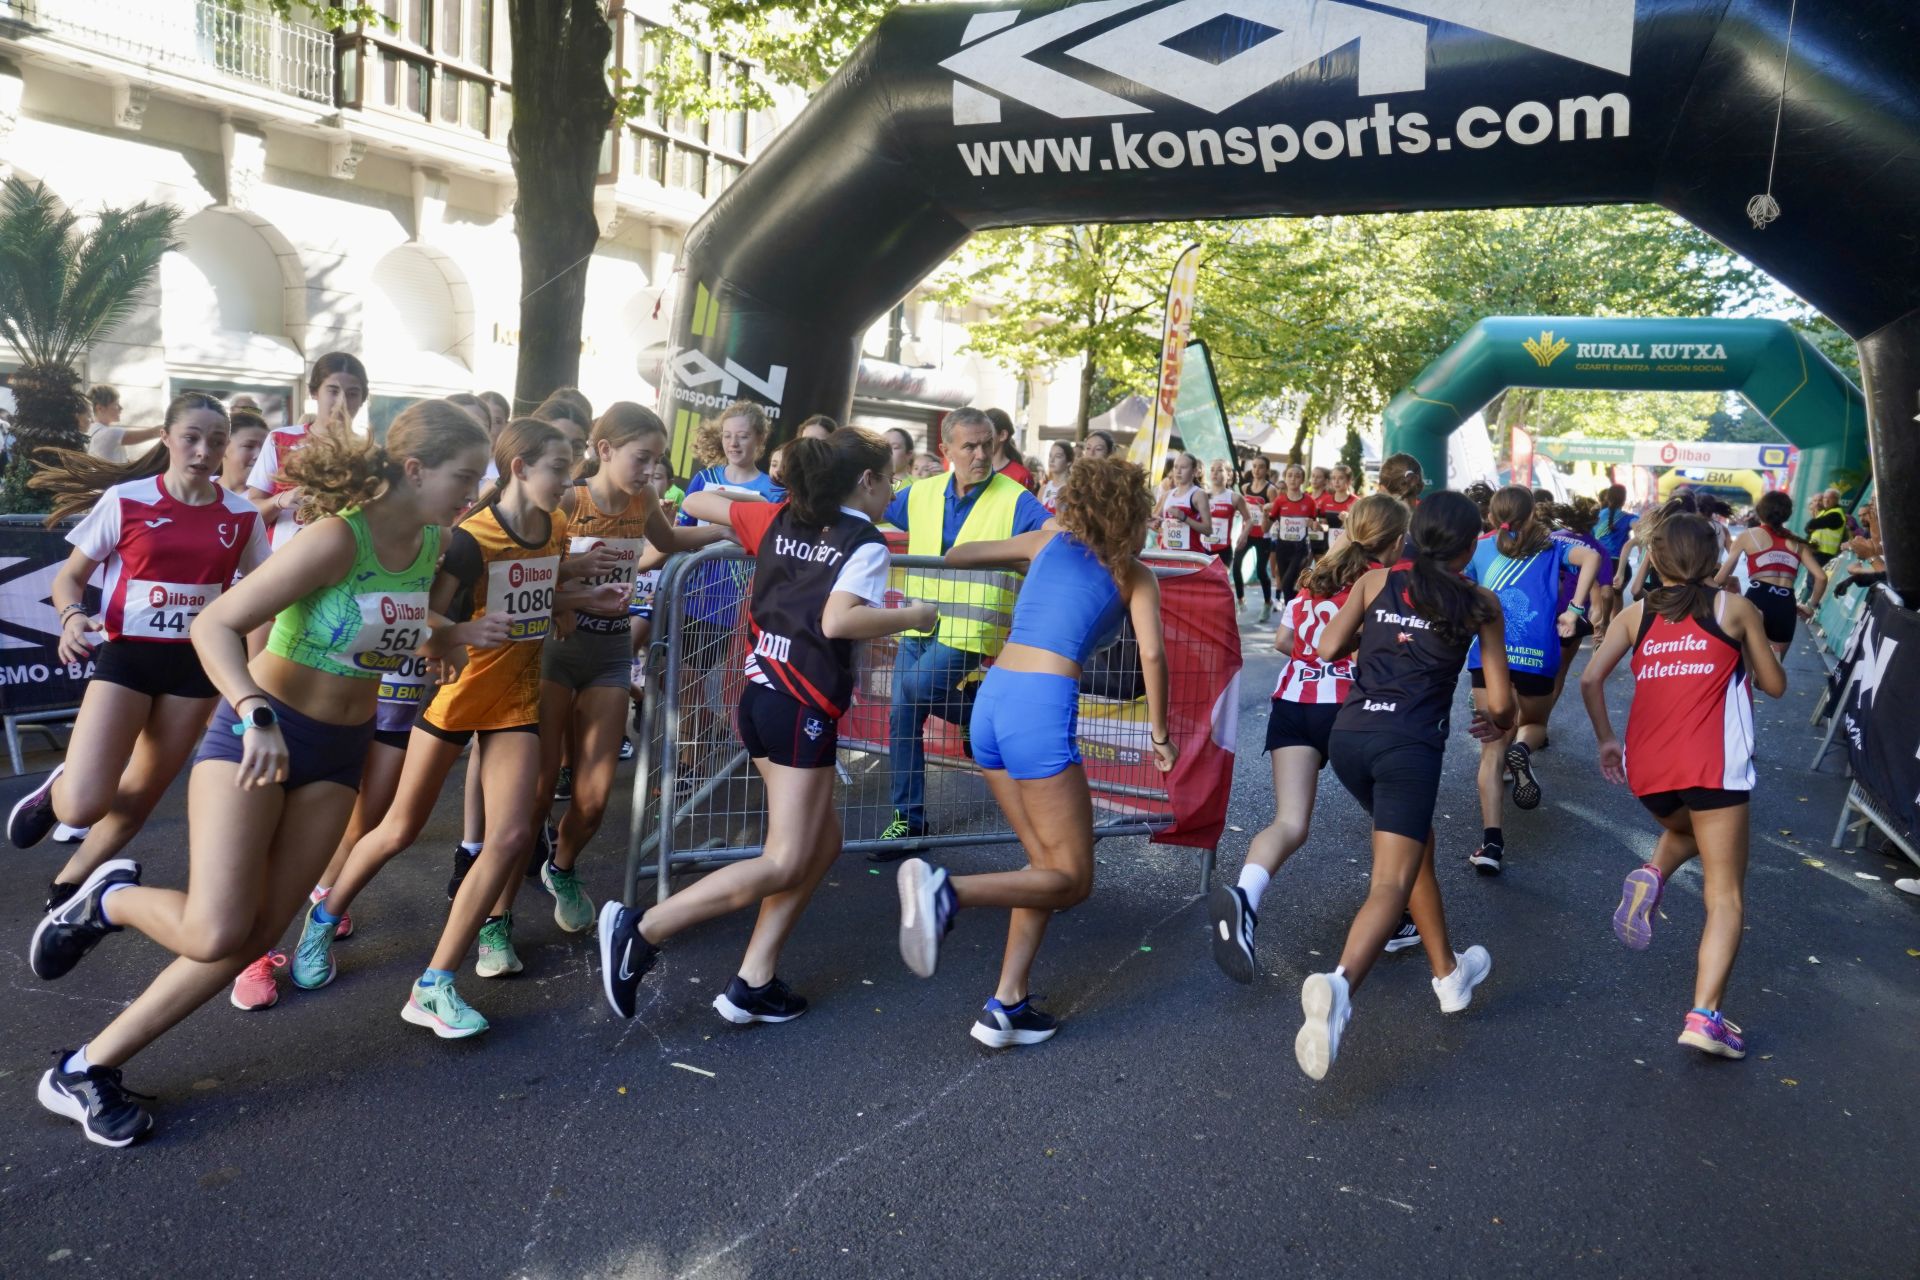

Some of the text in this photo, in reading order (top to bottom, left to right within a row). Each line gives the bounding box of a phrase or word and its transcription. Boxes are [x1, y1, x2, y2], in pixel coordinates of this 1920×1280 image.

[957, 92, 1631, 177] www.konsports.com
[1576, 343, 1727, 359] RURAL KUTXA
[1660, 443, 1711, 464] Bilbao
[1706, 472, 1733, 484] BM
[509, 563, 552, 588] Bilbao
[148, 585, 205, 609] Bilbao
[504, 587, 554, 615] 1080
[381, 596, 426, 626] Bilbao
[527, 618, 550, 635] BM
[376, 628, 421, 652] 561
[1642, 633, 1708, 657] Gernika
[1636, 660, 1715, 681] Atletismo
